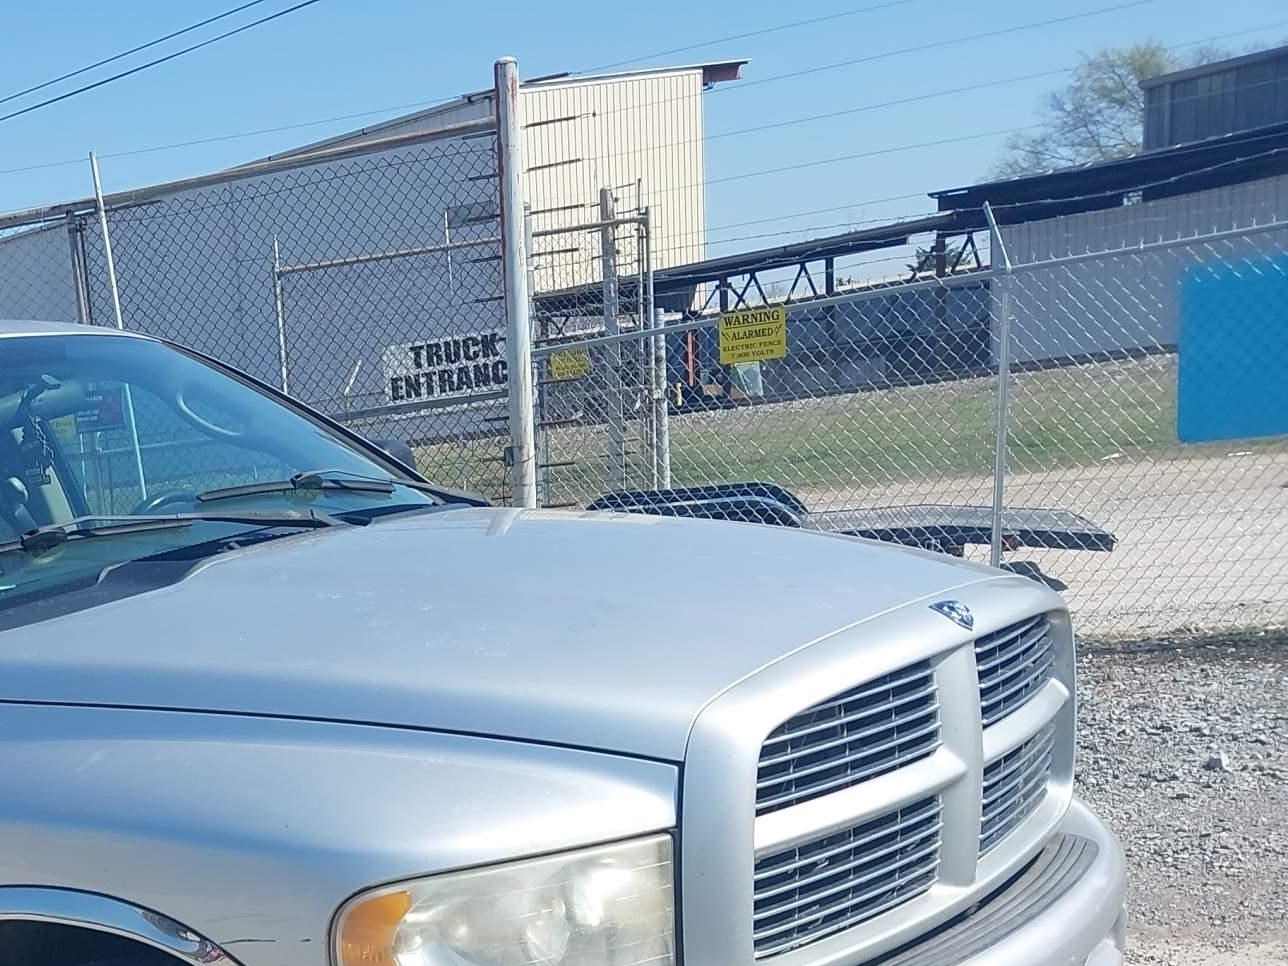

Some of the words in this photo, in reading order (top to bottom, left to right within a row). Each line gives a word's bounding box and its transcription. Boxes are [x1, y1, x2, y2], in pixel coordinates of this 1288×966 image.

[724, 310, 780, 328] WARNING
[731, 327, 774, 341] ALARMED
[409, 332, 500, 369] TRUCK
[722, 342, 757, 352] ELECTRIC
[758, 339, 782, 348] FENCE
[752, 348, 774, 356] VOLTS
[390, 360, 509, 402] ENTRANC
